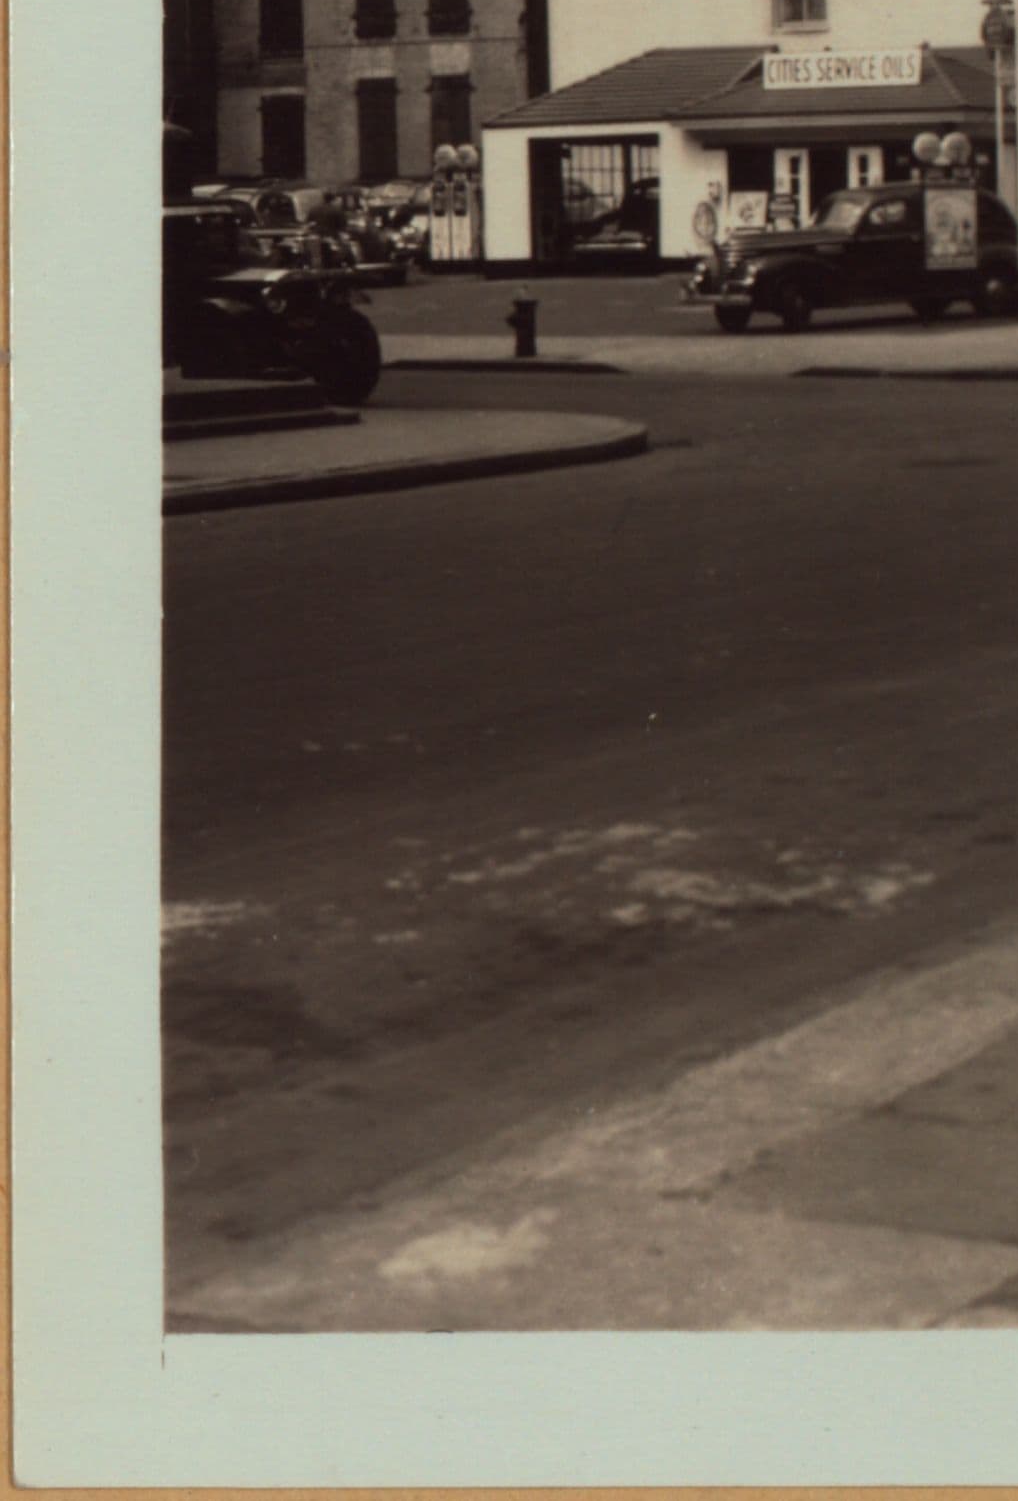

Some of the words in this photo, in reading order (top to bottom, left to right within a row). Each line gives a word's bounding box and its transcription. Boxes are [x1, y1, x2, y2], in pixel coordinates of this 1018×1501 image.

[767, 58, 812, 84] CITIES
[815, 56, 876, 82] SERVICE
[880, 53, 915, 79] OILS
